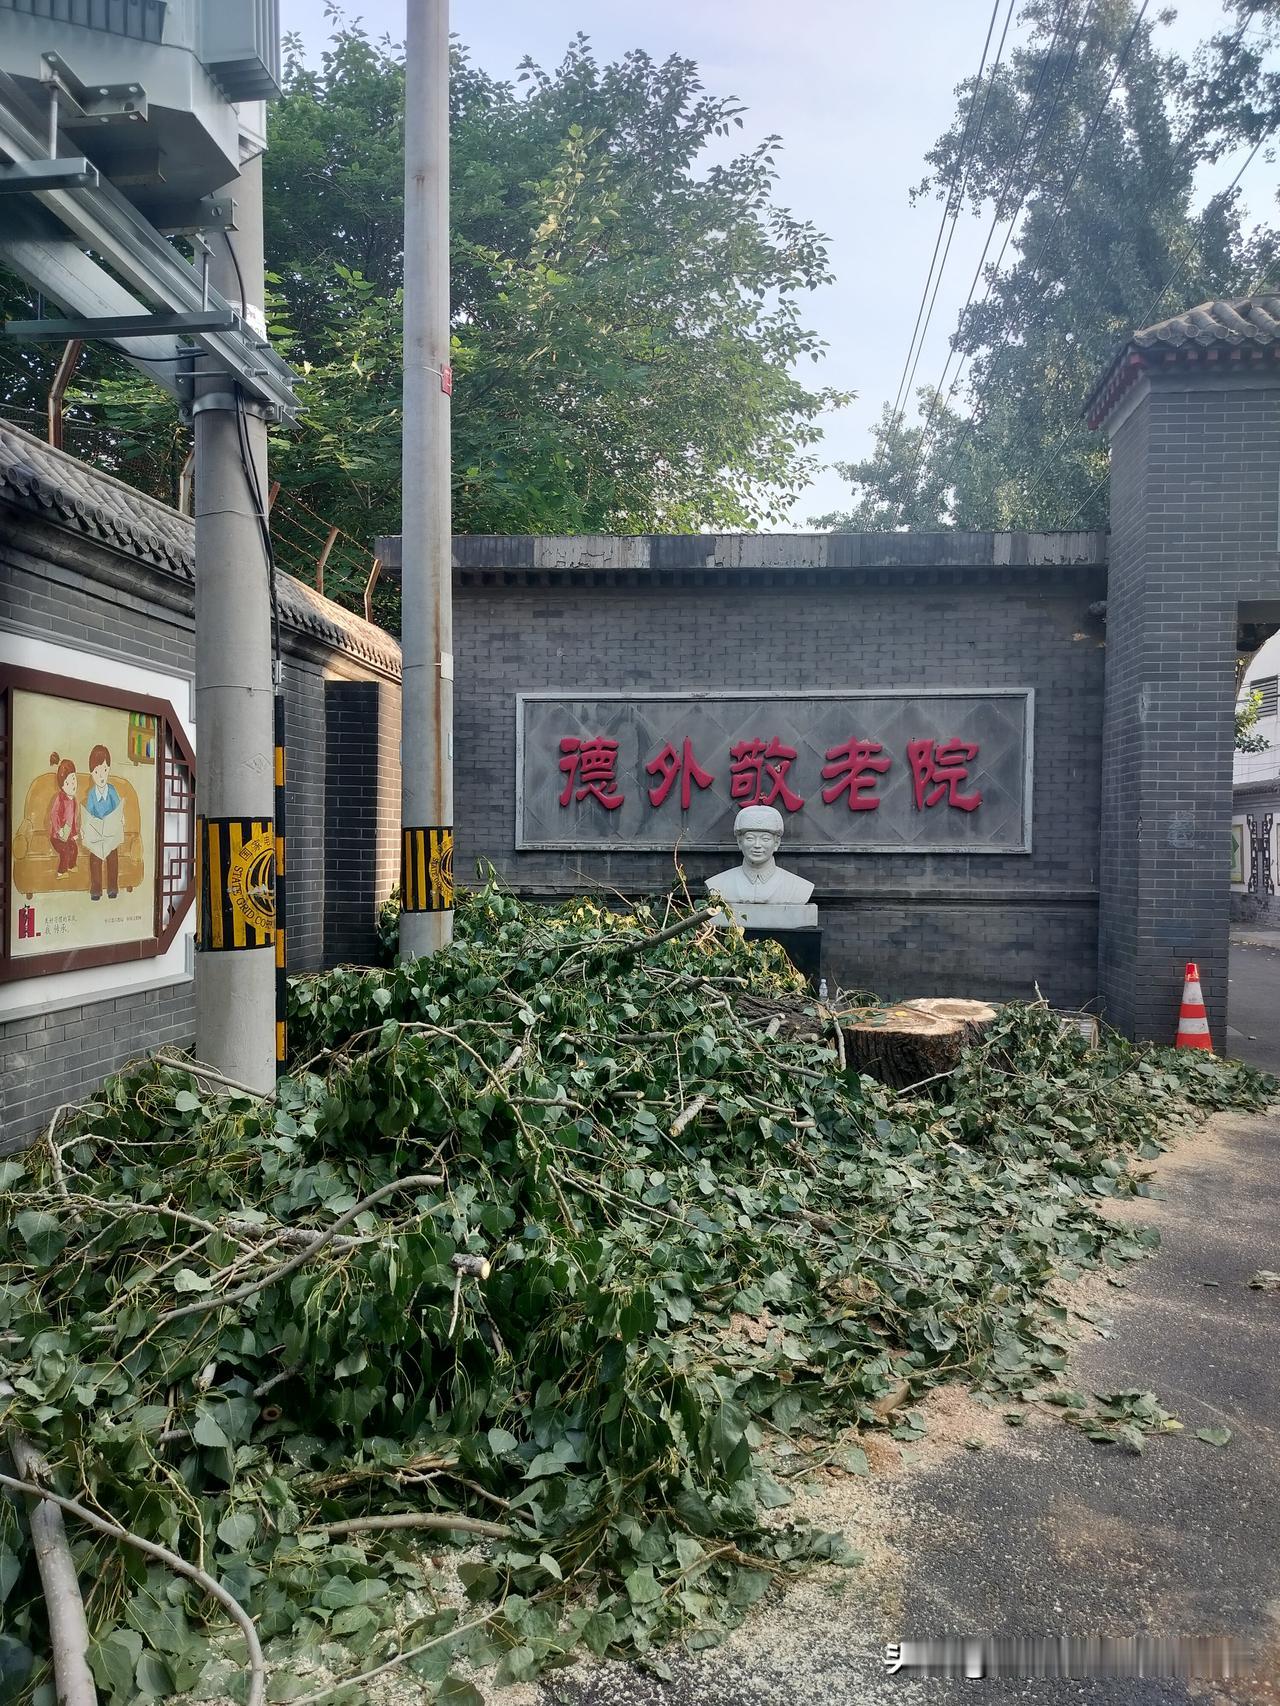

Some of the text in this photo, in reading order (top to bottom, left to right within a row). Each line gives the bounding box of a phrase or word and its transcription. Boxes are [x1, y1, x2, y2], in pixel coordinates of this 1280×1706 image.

[559, 735, 983, 812] 德外敬老院
[232, 865, 243, 896] STATE
[236, 897, 255, 919] GRID
